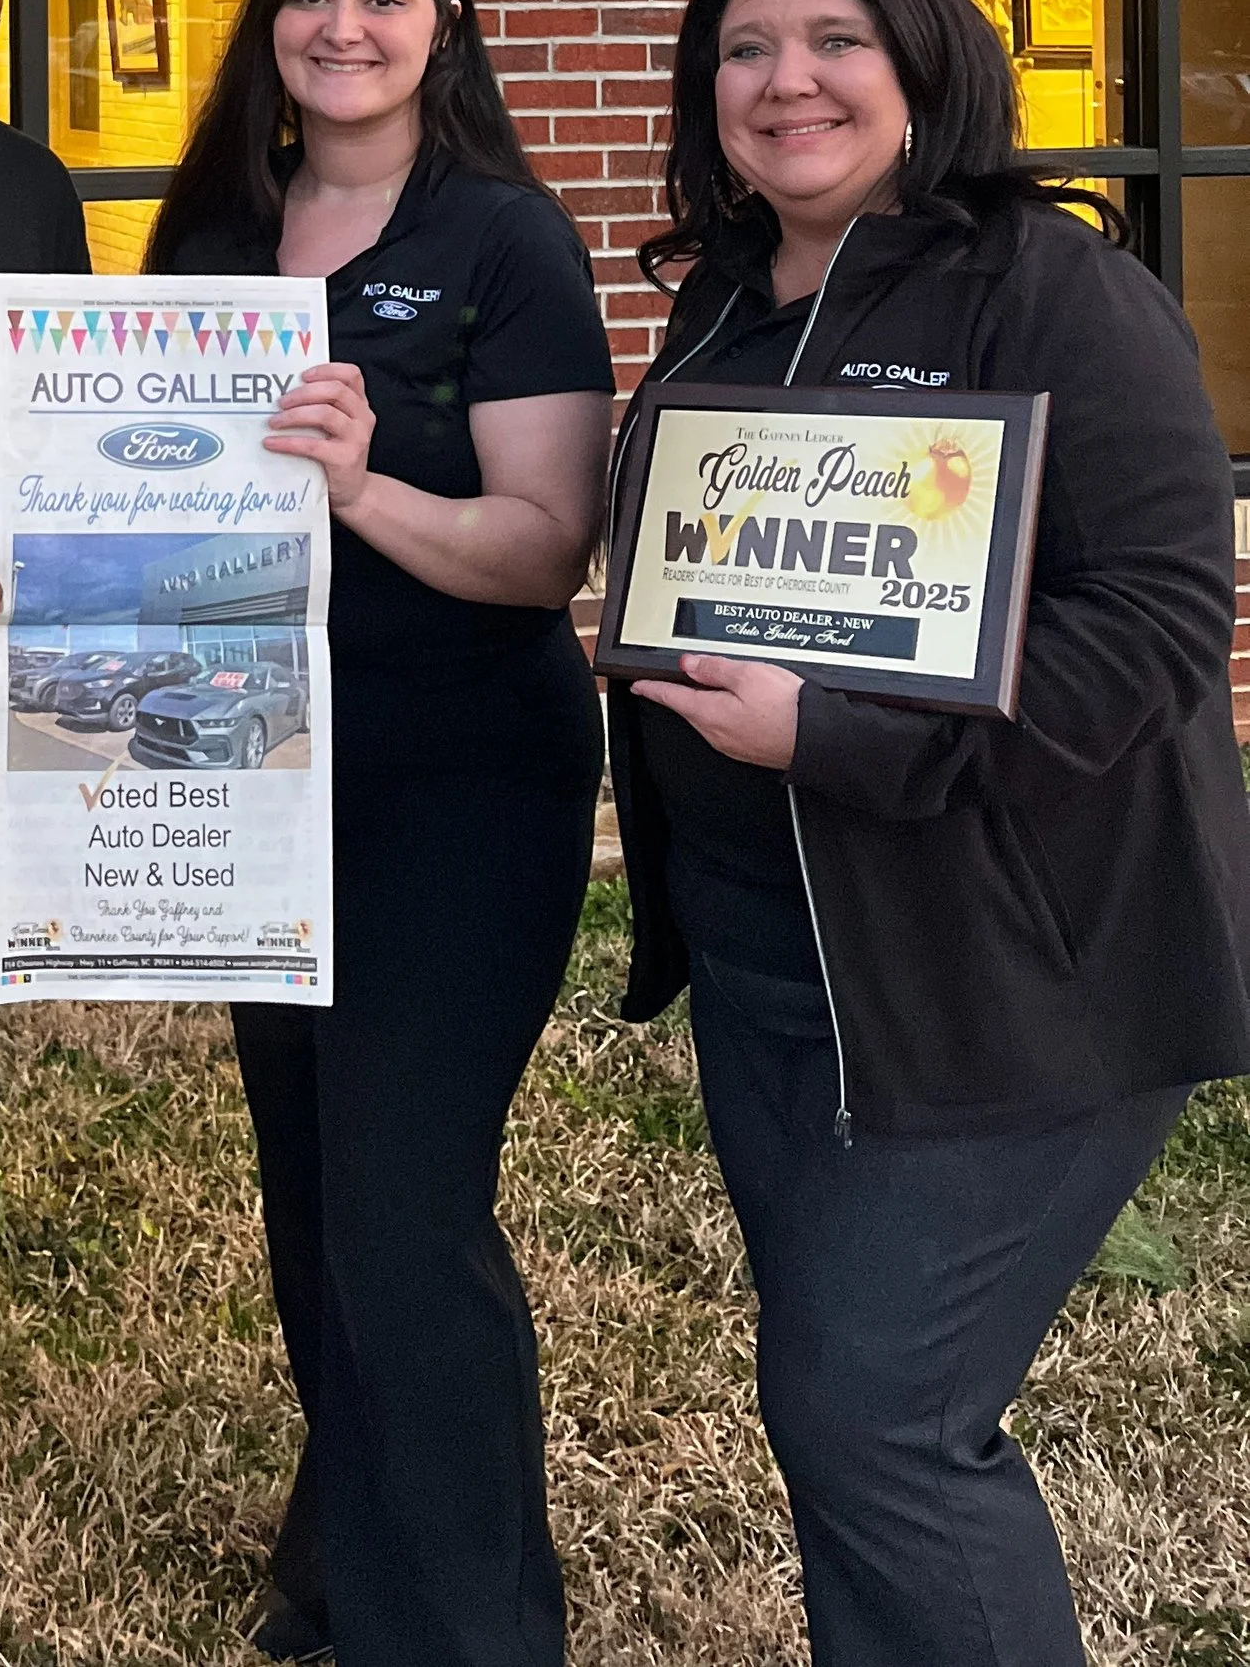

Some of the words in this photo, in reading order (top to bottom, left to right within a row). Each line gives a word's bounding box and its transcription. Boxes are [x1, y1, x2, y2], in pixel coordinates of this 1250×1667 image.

[378, 301, 410, 318] Ford
[30, 372, 124, 404] AUTO
[137, 372, 295, 404] GALLERY
[840, 363, 882, 378] AUTO
[885, 364, 950, 387] GALLER
[122, 429, 199, 462] Ford
[735, 426, 755, 441] THE
[758, 427, 802, 442] GAFFNEY
[804, 429, 844, 444] LEDGER
[698, 442, 801, 511] Golden
[804, 442, 911, 508] Peach
[18, 474, 88, 512] Thank
[88, 490, 129, 526] you
[127, 481, 168, 526] for
[168, 480, 237, 526] voting
[233, 481, 273, 527] for
[274, 478, 311, 513] us!
[204, 534, 310, 580] GALLERY
[698, 570, 726, 585] CHOICE
[727, 573, 743, 586] FOR
[744, 574, 764, 588] BEST
[764, 577, 775, 590] OF
[776, 575, 817, 592] CHEROKEE
[818, 579, 851, 594] COUNTY
[879, 579, 972, 612] 2025
[714, 604, 746, 618] BEST
[745, 607, 781, 622] AUTO
[782, 610, 834, 627] DEALER
[842, 616, 876, 631] NEW
[725, 621, 760, 636] Auto
[763, 621, 811, 645] Gallery
[814, 628, 855, 647] Ford
[168, 781, 231, 809] Best
[88, 824, 145, 850] Auto
[152, 822, 232, 849] Dealer
[84, 862, 139, 888] New
[145, 862, 164, 888] &
[172, 862, 235, 888] Used
[97, 899, 132, 917] Thank
[132, 898, 158, 921] You
[158, 898, 200, 921] Gaffney
[201, 902, 225, 917] and
[69, 925, 120, 943] Cherokee
[120, 925, 158, 947] County
[157, 928, 176, 948] for
[176, 925, 207, 947] Your
[206, 925, 251, 948] Support!
